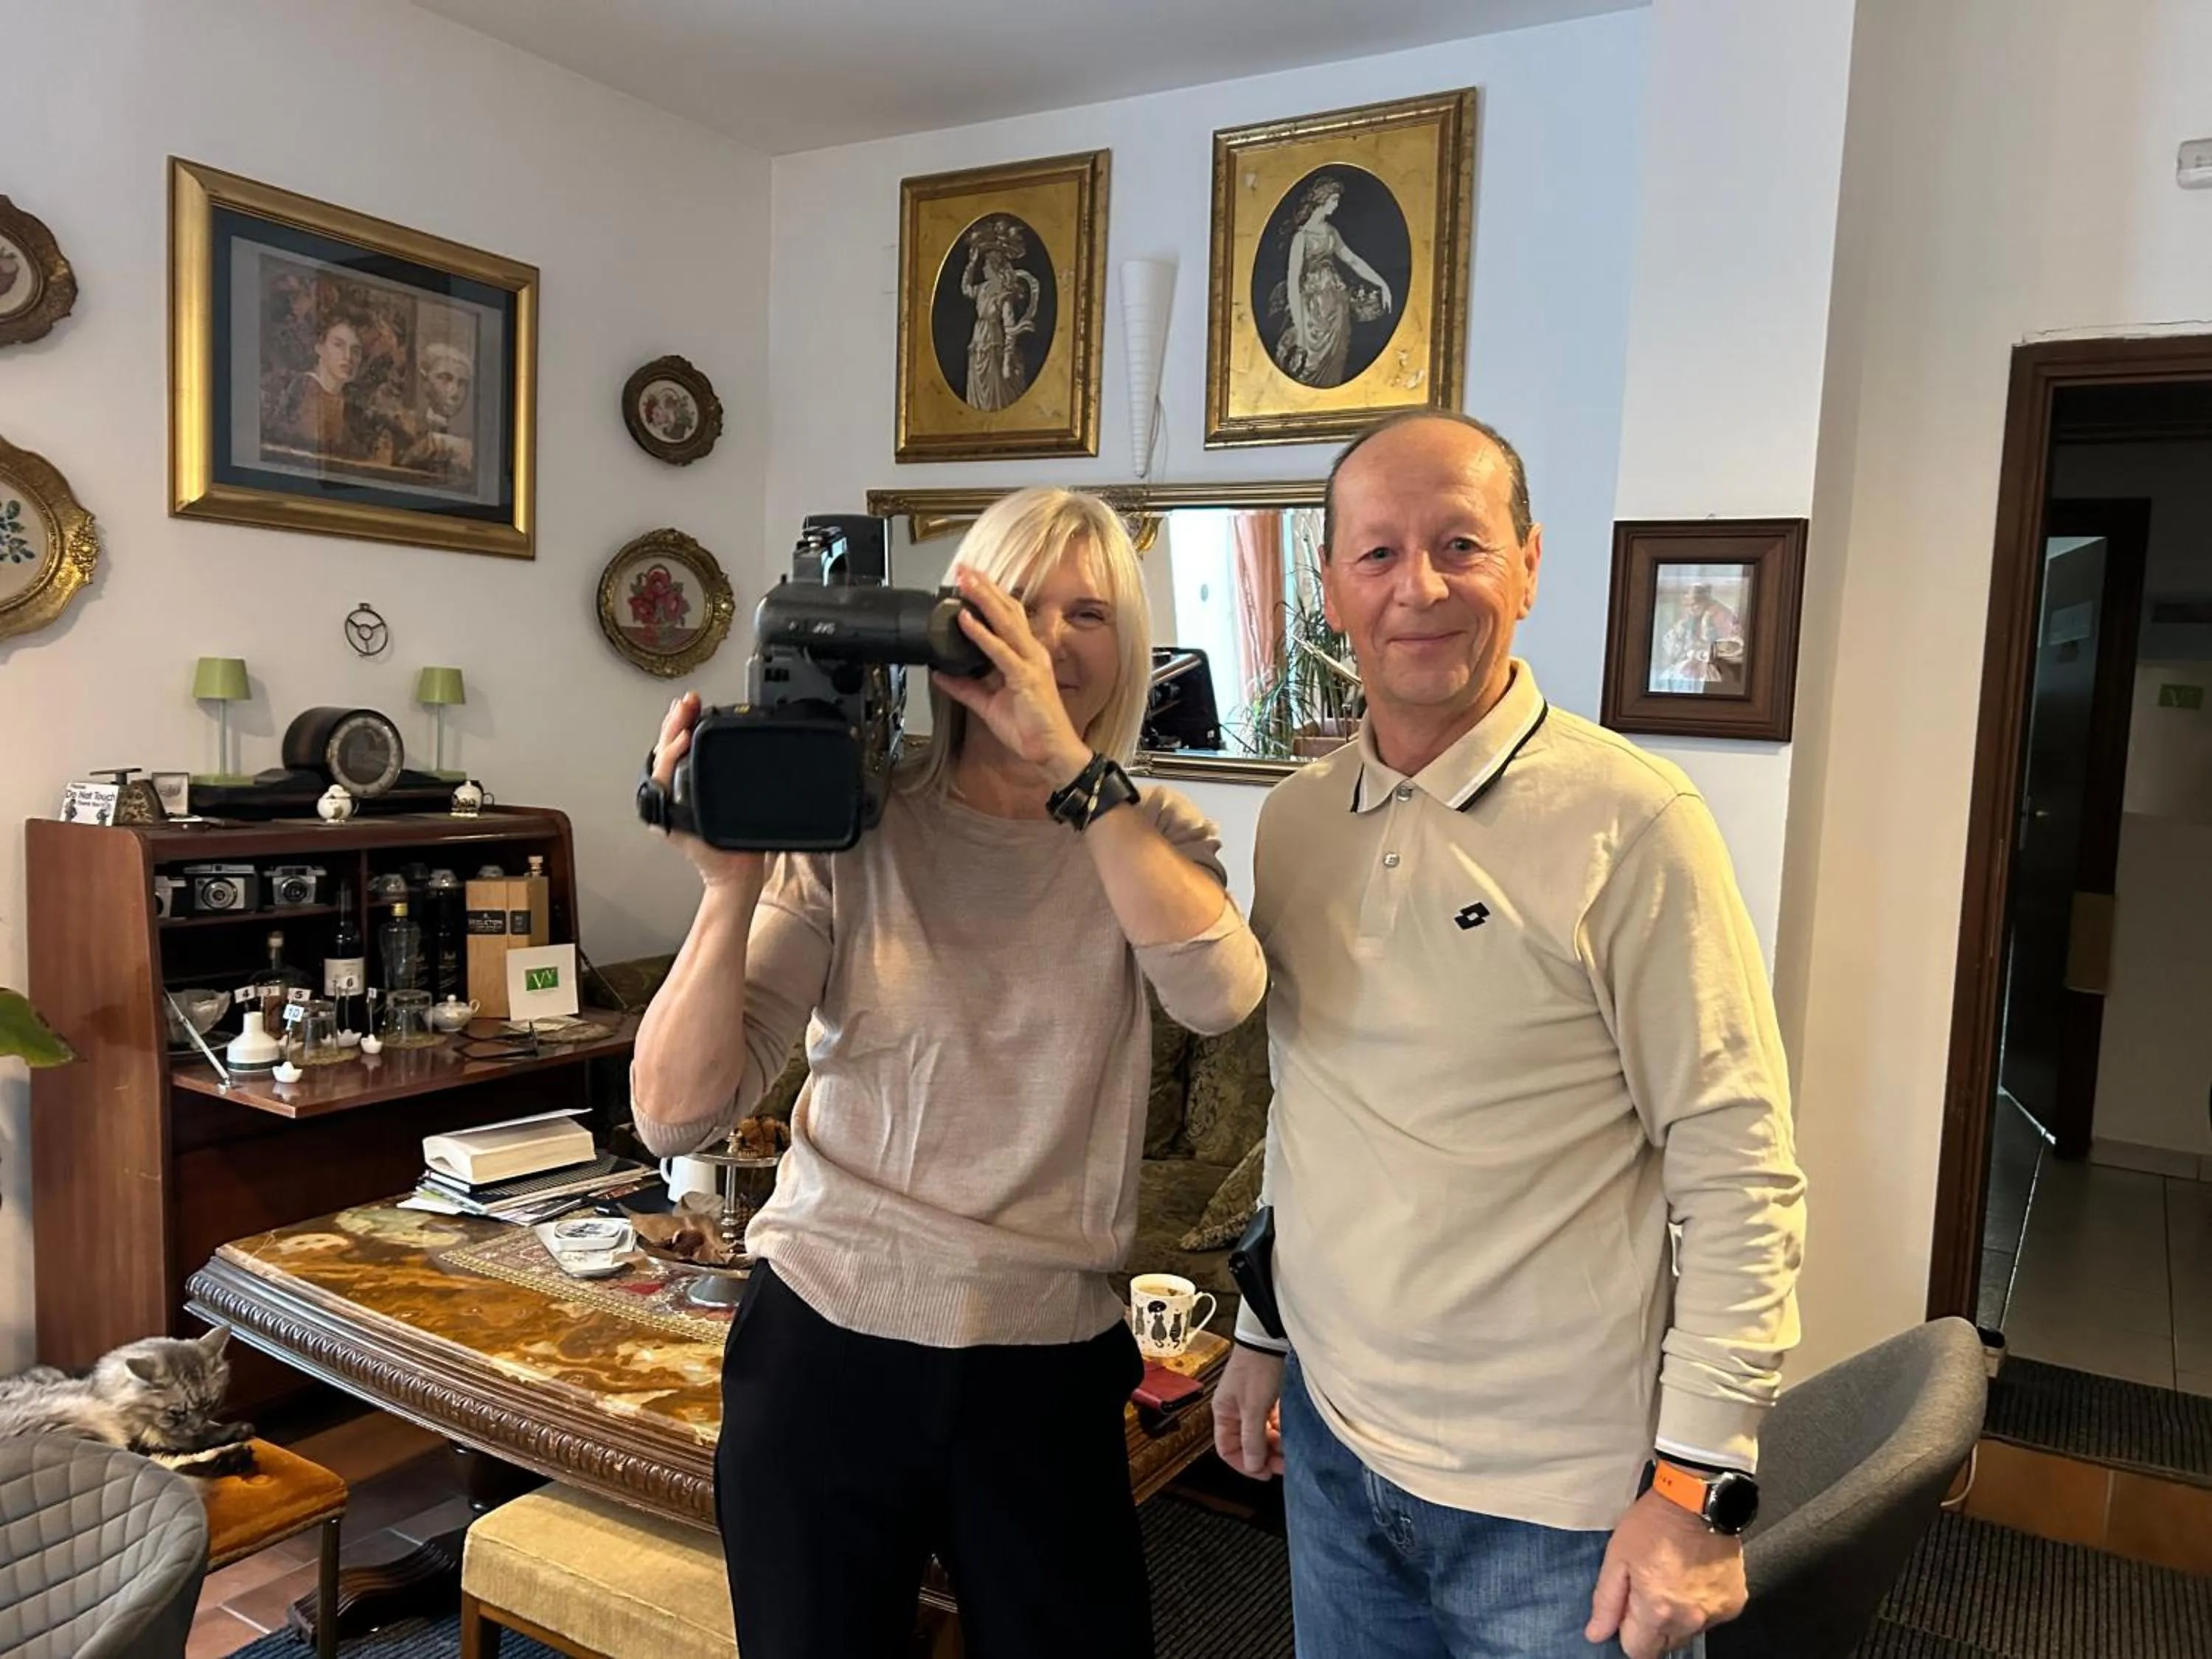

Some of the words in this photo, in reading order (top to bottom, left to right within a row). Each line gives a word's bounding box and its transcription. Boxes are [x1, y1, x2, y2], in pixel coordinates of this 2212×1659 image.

[66, 790, 77, 799] Do
[78, 790, 92, 800] Not
[94, 791, 116, 801] Touch
[346, 977, 353, 987] 6
[242, 989, 250, 998] 4
[294, 990, 303, 999] 5
[288, 1007, 301, 1018] 10
